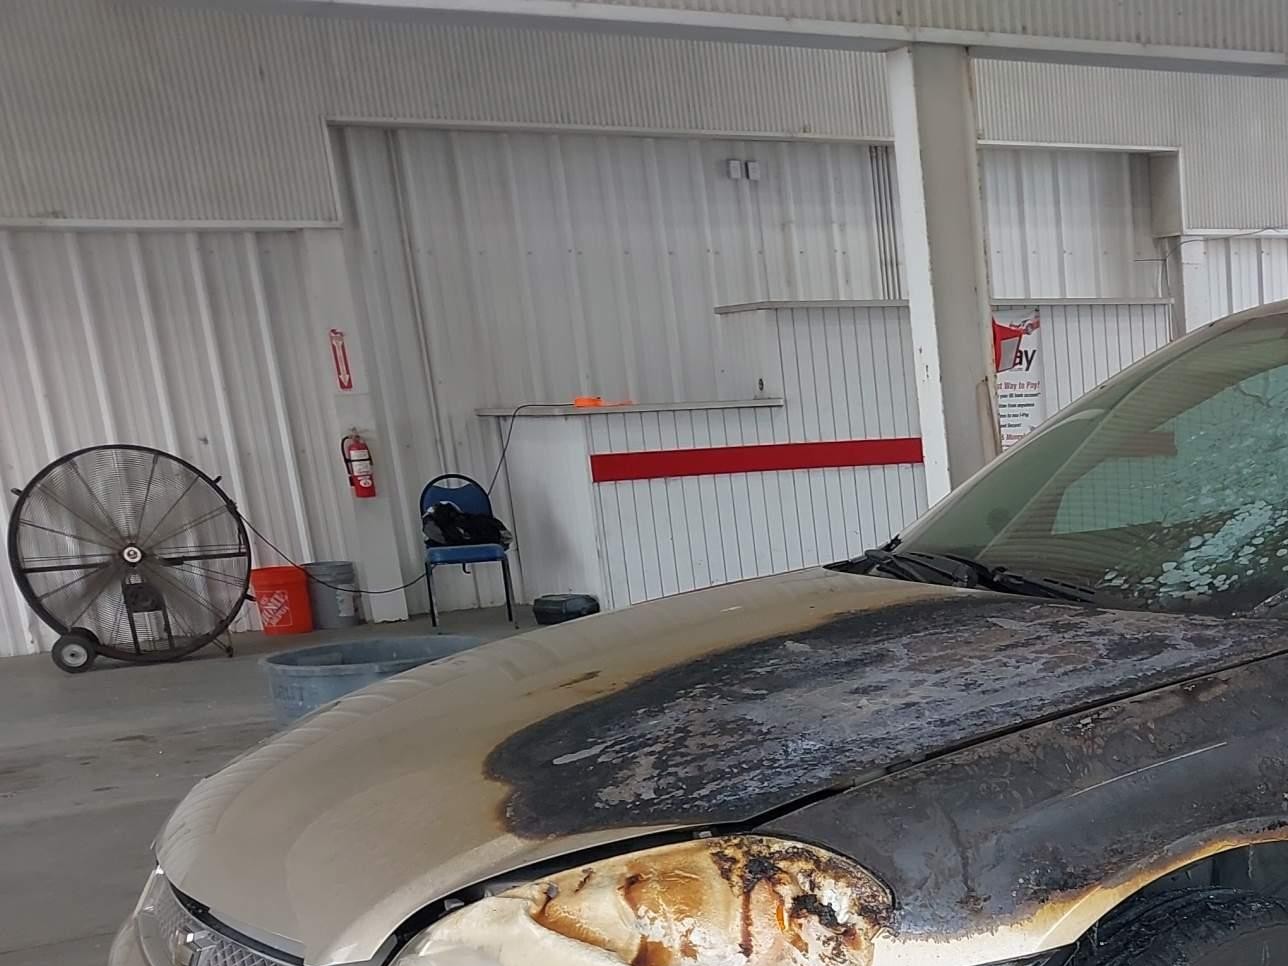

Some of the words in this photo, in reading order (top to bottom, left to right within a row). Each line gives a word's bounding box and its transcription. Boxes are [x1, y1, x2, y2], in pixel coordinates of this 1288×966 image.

[1014, 349, 1037, 371] ay
[1004, 382, 1017, 391] Way
[1019, 381, 1025, 389] to
[1026, 380, 1040, 390] Pay!
